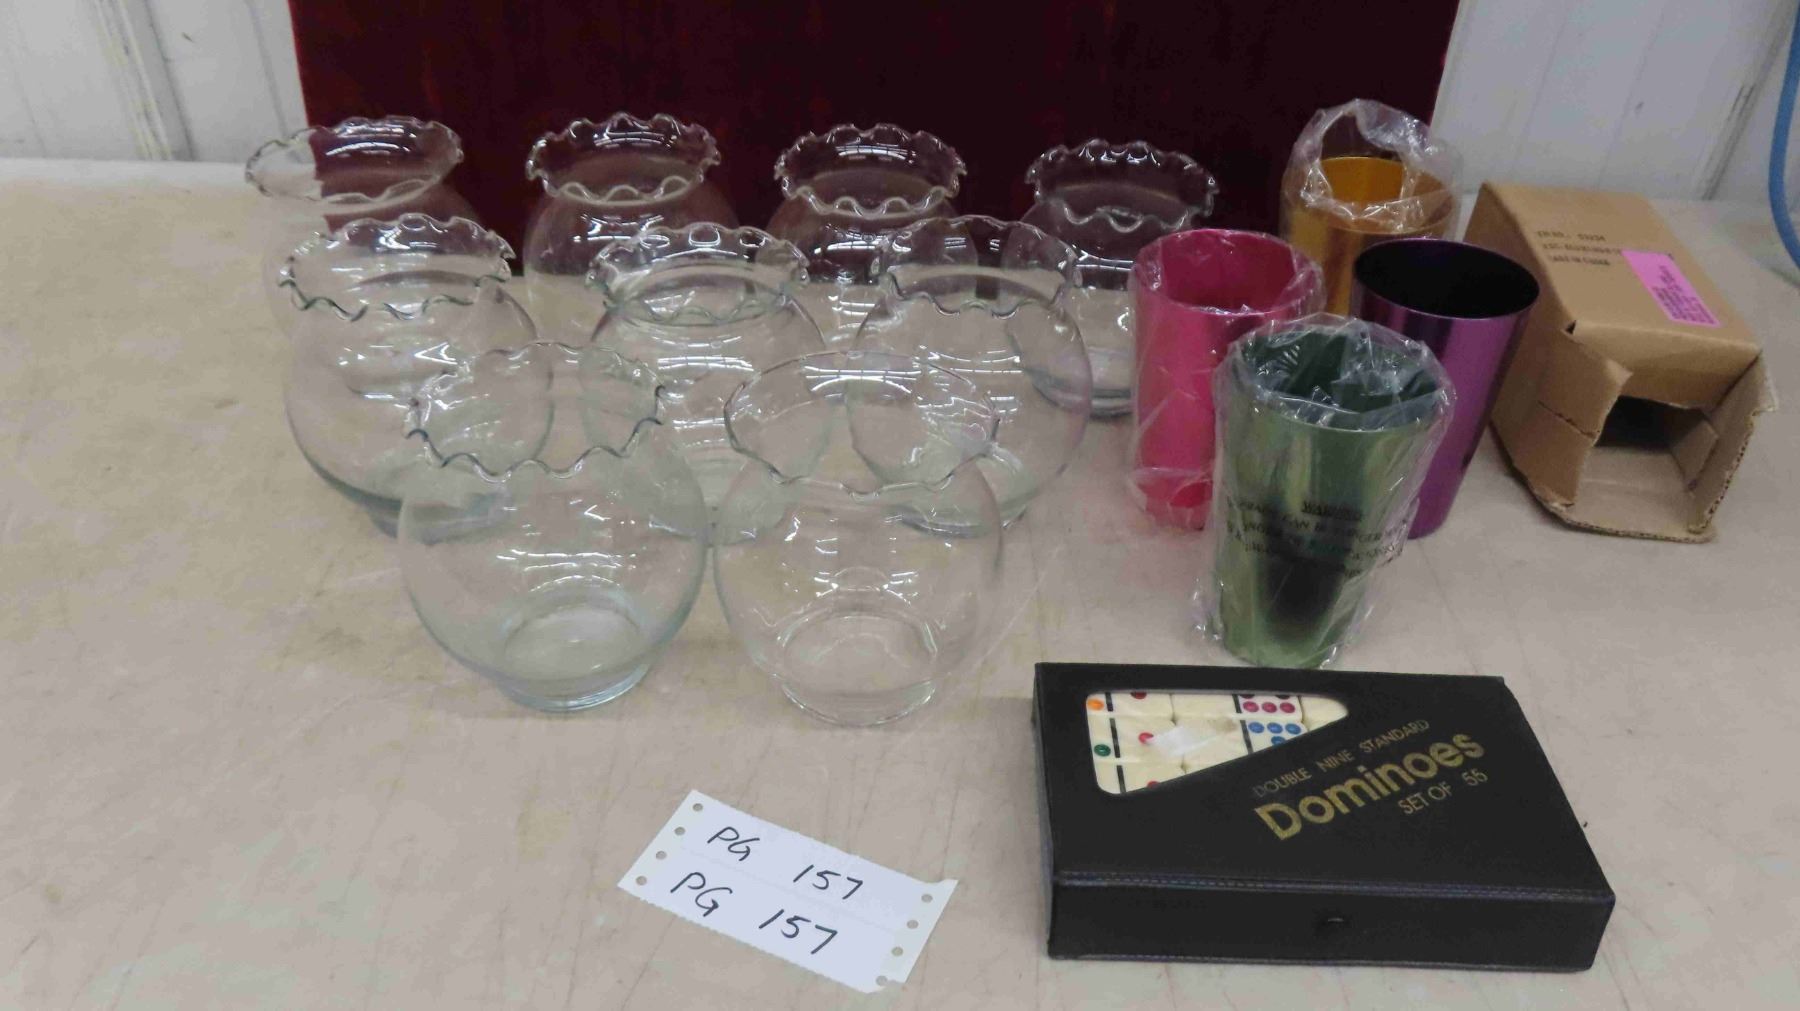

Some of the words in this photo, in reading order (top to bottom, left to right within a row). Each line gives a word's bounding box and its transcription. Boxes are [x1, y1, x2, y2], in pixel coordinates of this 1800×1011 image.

[1253, 767, 1313, 798] DOUBLE
[1317, 750, 1356, 773] NINE
[1359, 719, 1430, 754] STANDARD
[1253, 734, 1485, 841] Dominoes
[1398, 791, 1430, 815] SET
[1428, 780, 1453, 802] OF
[1461, 768, 1489, 787] 55
[707, 826, 761, 862] PG
[793, 864, 863, 900] 157
[670, 871, 733, 917] PG
[758, 908, 838, 955] 157
